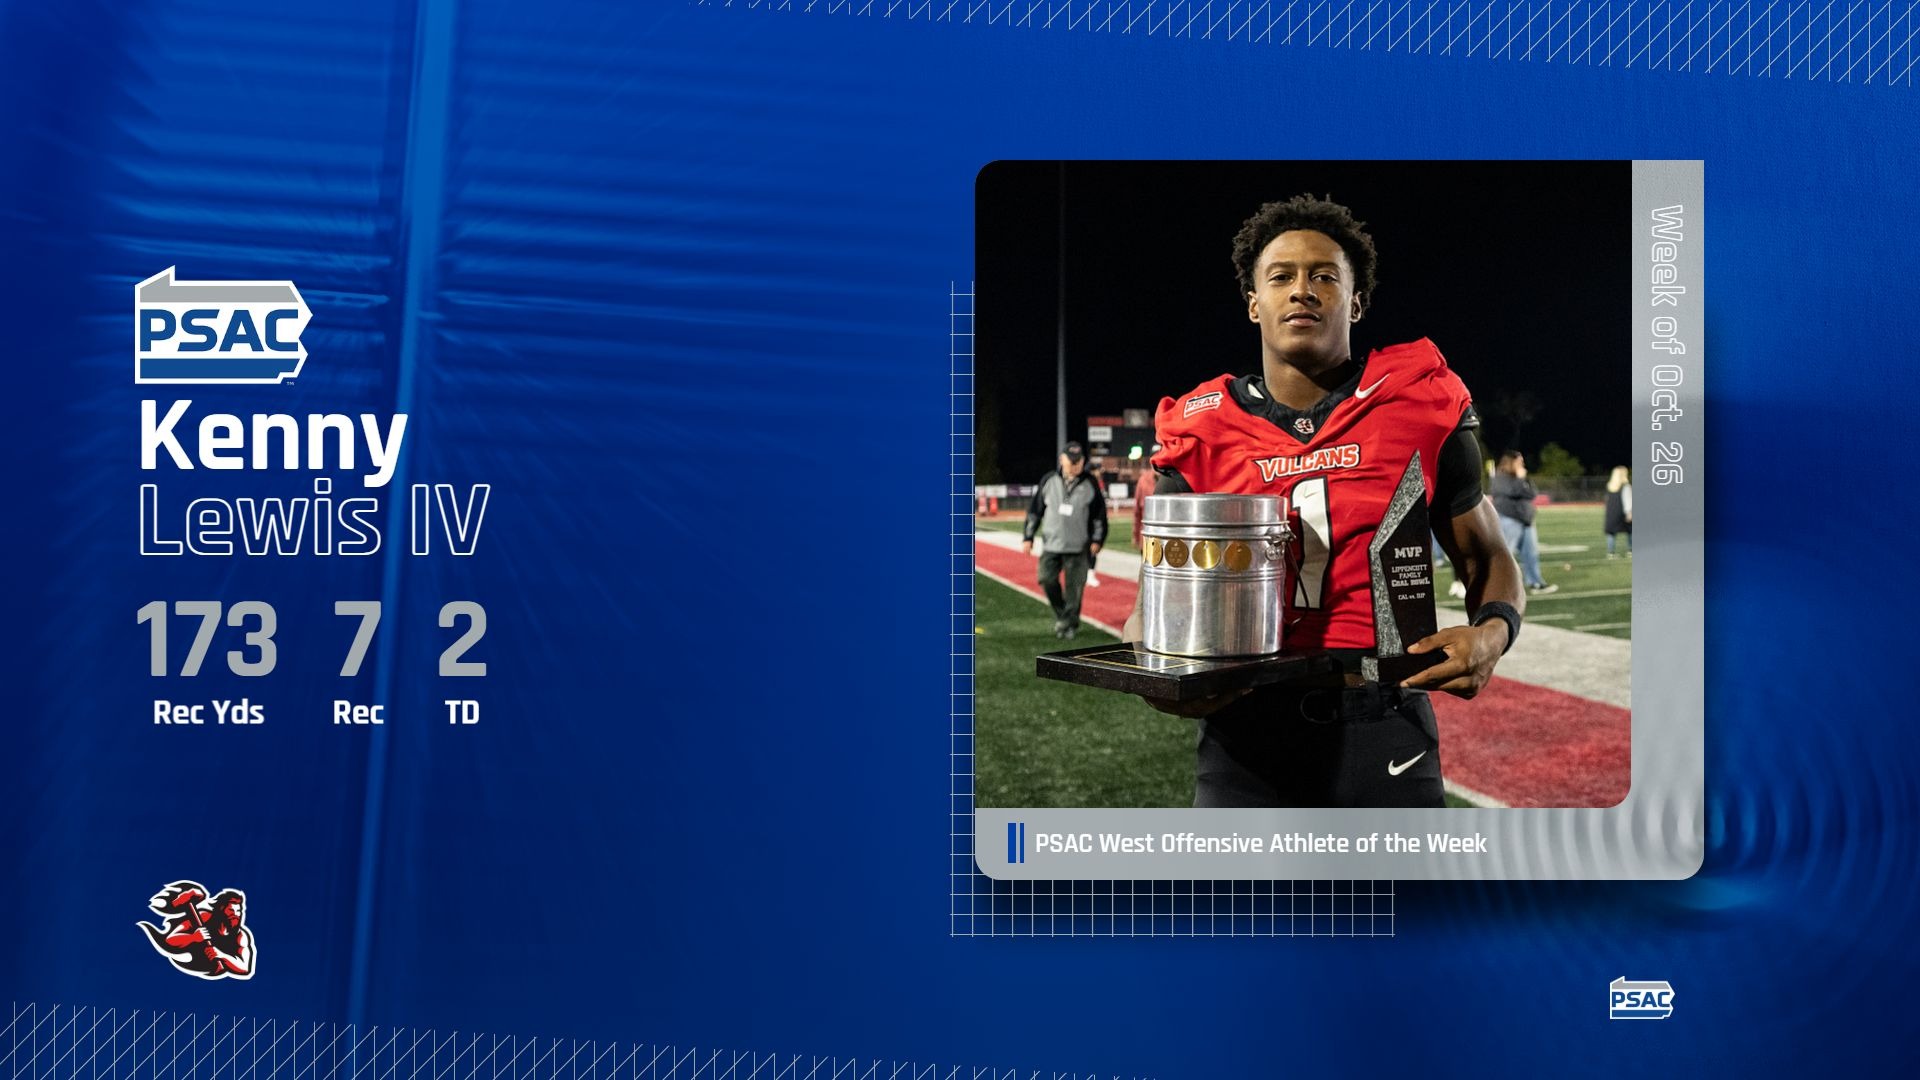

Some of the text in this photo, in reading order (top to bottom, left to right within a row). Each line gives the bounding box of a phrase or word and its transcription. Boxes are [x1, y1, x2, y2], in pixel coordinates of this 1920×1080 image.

[1255, 444, 1360, 482] VULCANS
[1290, 476, 1331, 609] 1
[1394, 547, 1422, 558] MVP
